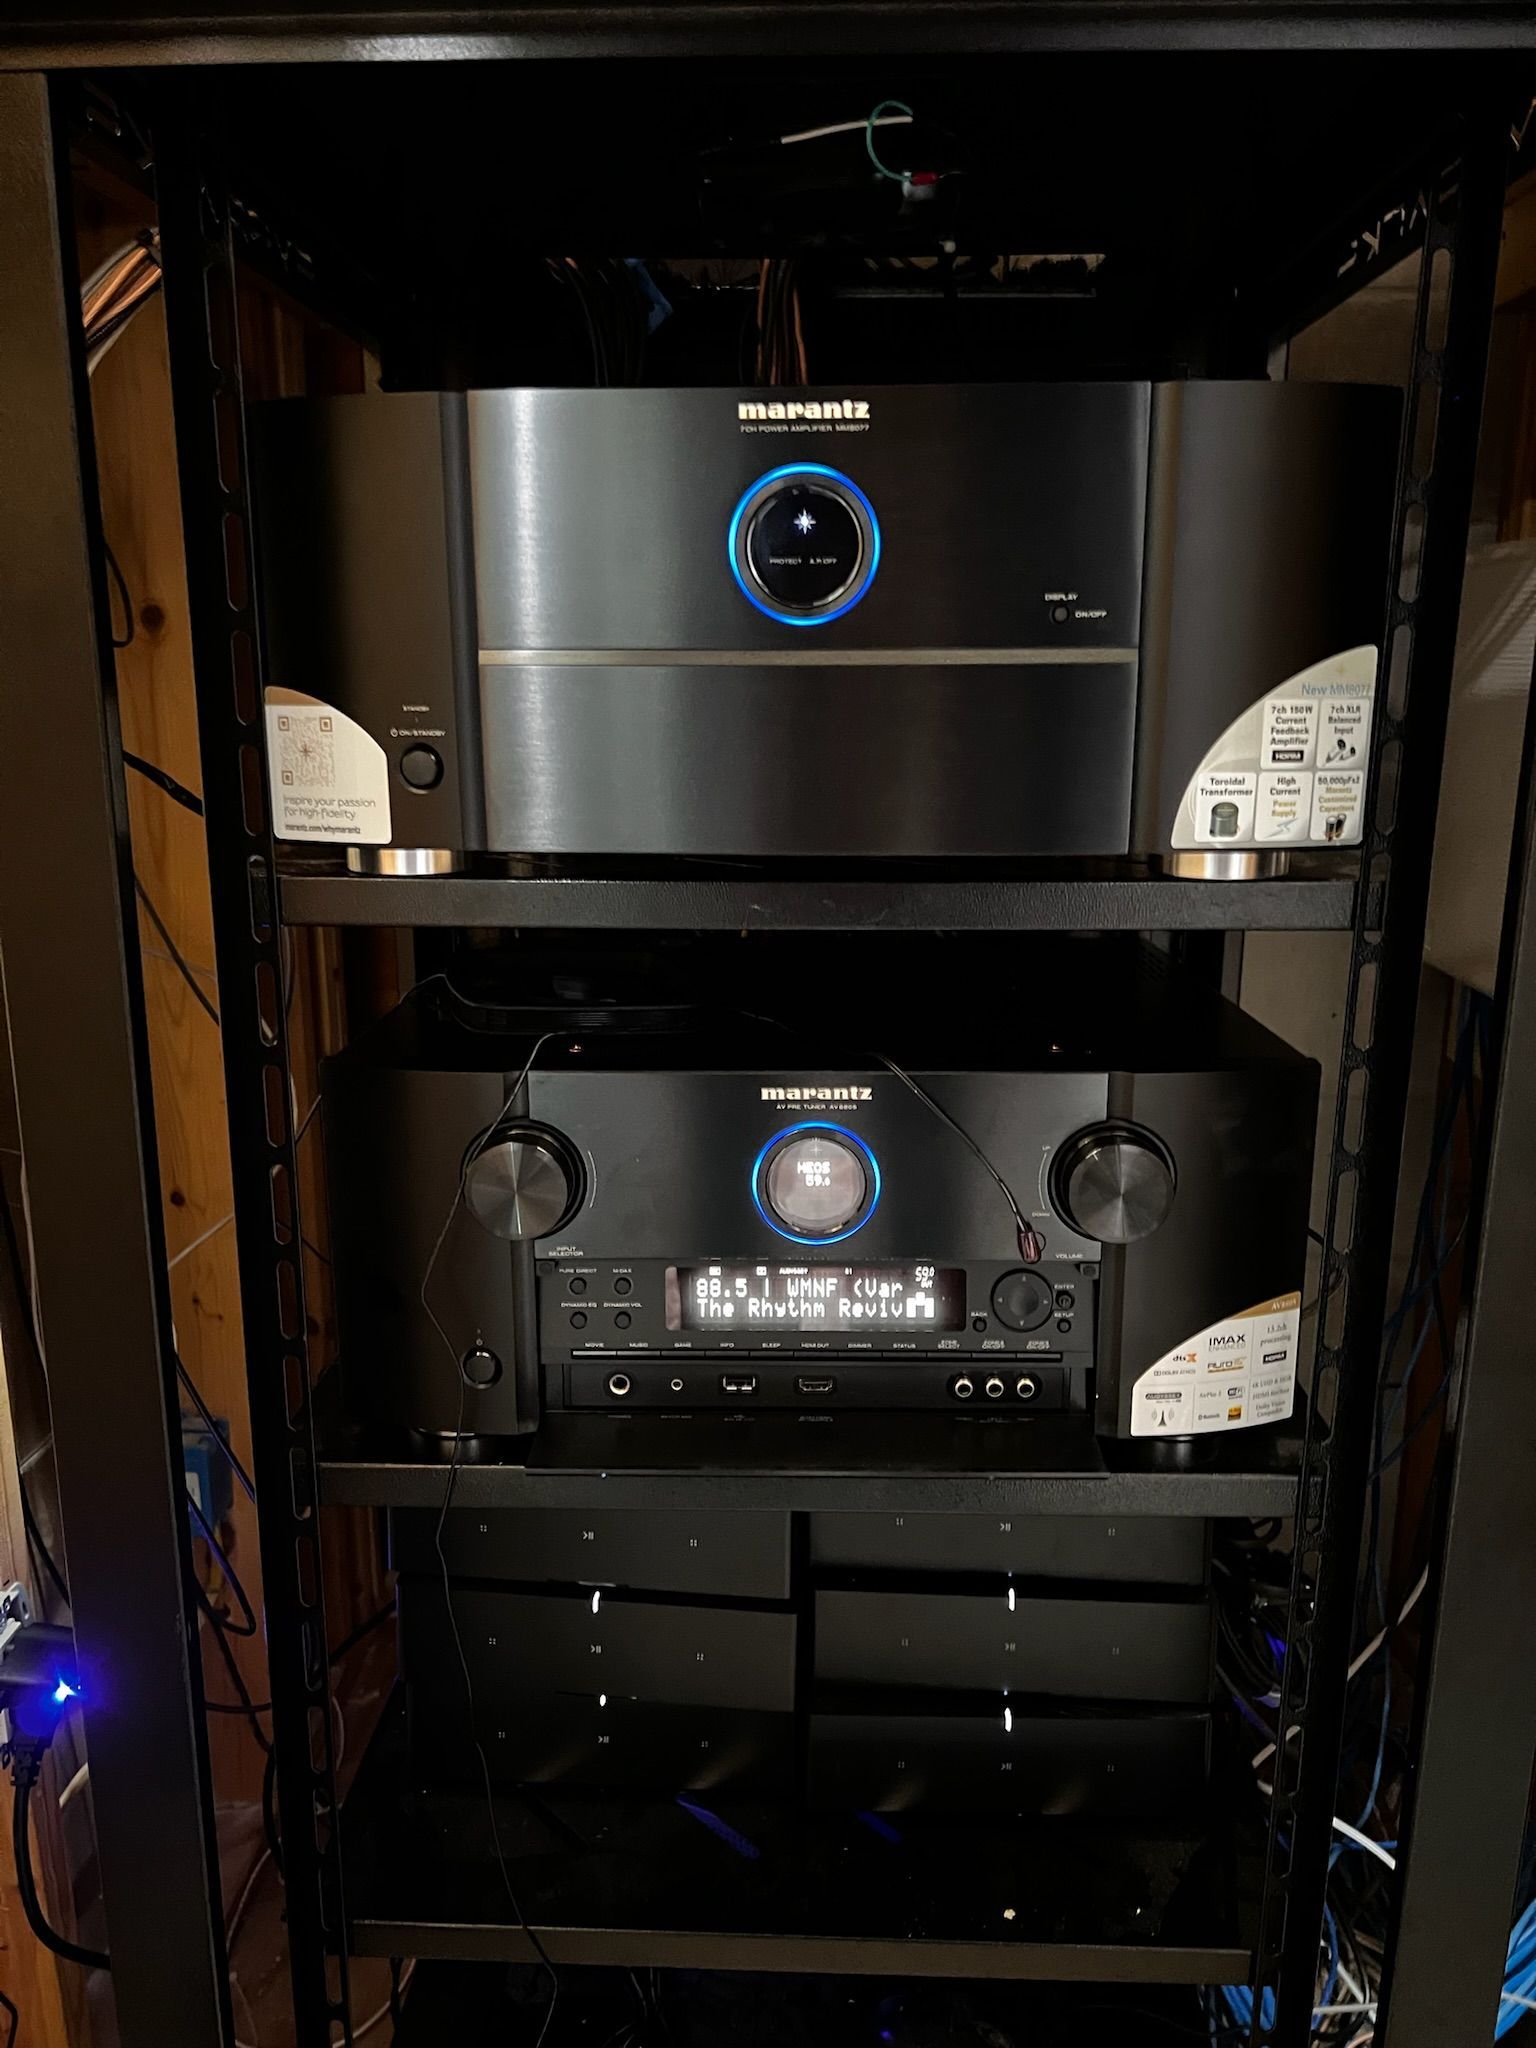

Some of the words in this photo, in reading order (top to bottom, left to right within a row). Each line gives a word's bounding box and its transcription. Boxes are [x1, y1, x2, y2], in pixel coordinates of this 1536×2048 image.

[738, 399, 870, 420] marantz
[758, 424, 788, 433] POWER
[790, 424, 832, 433] AMPLIFIER
[769, 557, 801, 565] PROTECT
[1044, 593, 1079, 601] DISPLAY
[1301, 683, 1327, 697] New
[1271, 706, 1287, 715] 7ch
[1331, 706, 1345, 715] 7ch
[1275, 716, 1307, 725] Current
[1270, 726, 1309, 736] Feedback
[1334, 726, 1354, 736] Input
[1270, 737, 1309, 748] Amplifier
[1210, 776, 1246, 786] Toroidal
[1277, 776, 1297, 787] High
[1201, 788, 1254, 797] Transformer
[1269, 787, 1302, 796] Current
[312, 798, 335, 808] your
[337, 799, 377, 809] passion
[284, 805, 298, 818] for
[299, 807, 356, 821] high-fidelity
[760, 1086, 873, 1101] marantz
[797, 1161, 831, 1174] HEOS
[697, 1278, 748, 1298] 88.5
[787, 1278, 838, 1298] WMNF
[854, 1278, 903, 1298] (Var
[697, 1298, 734, 1318] The
[748, 1297, 825, 1318] Rhythm
[839, 1297, 903, 1318] Reviv
[1209, 1334, 1246, 1346] IMAX
